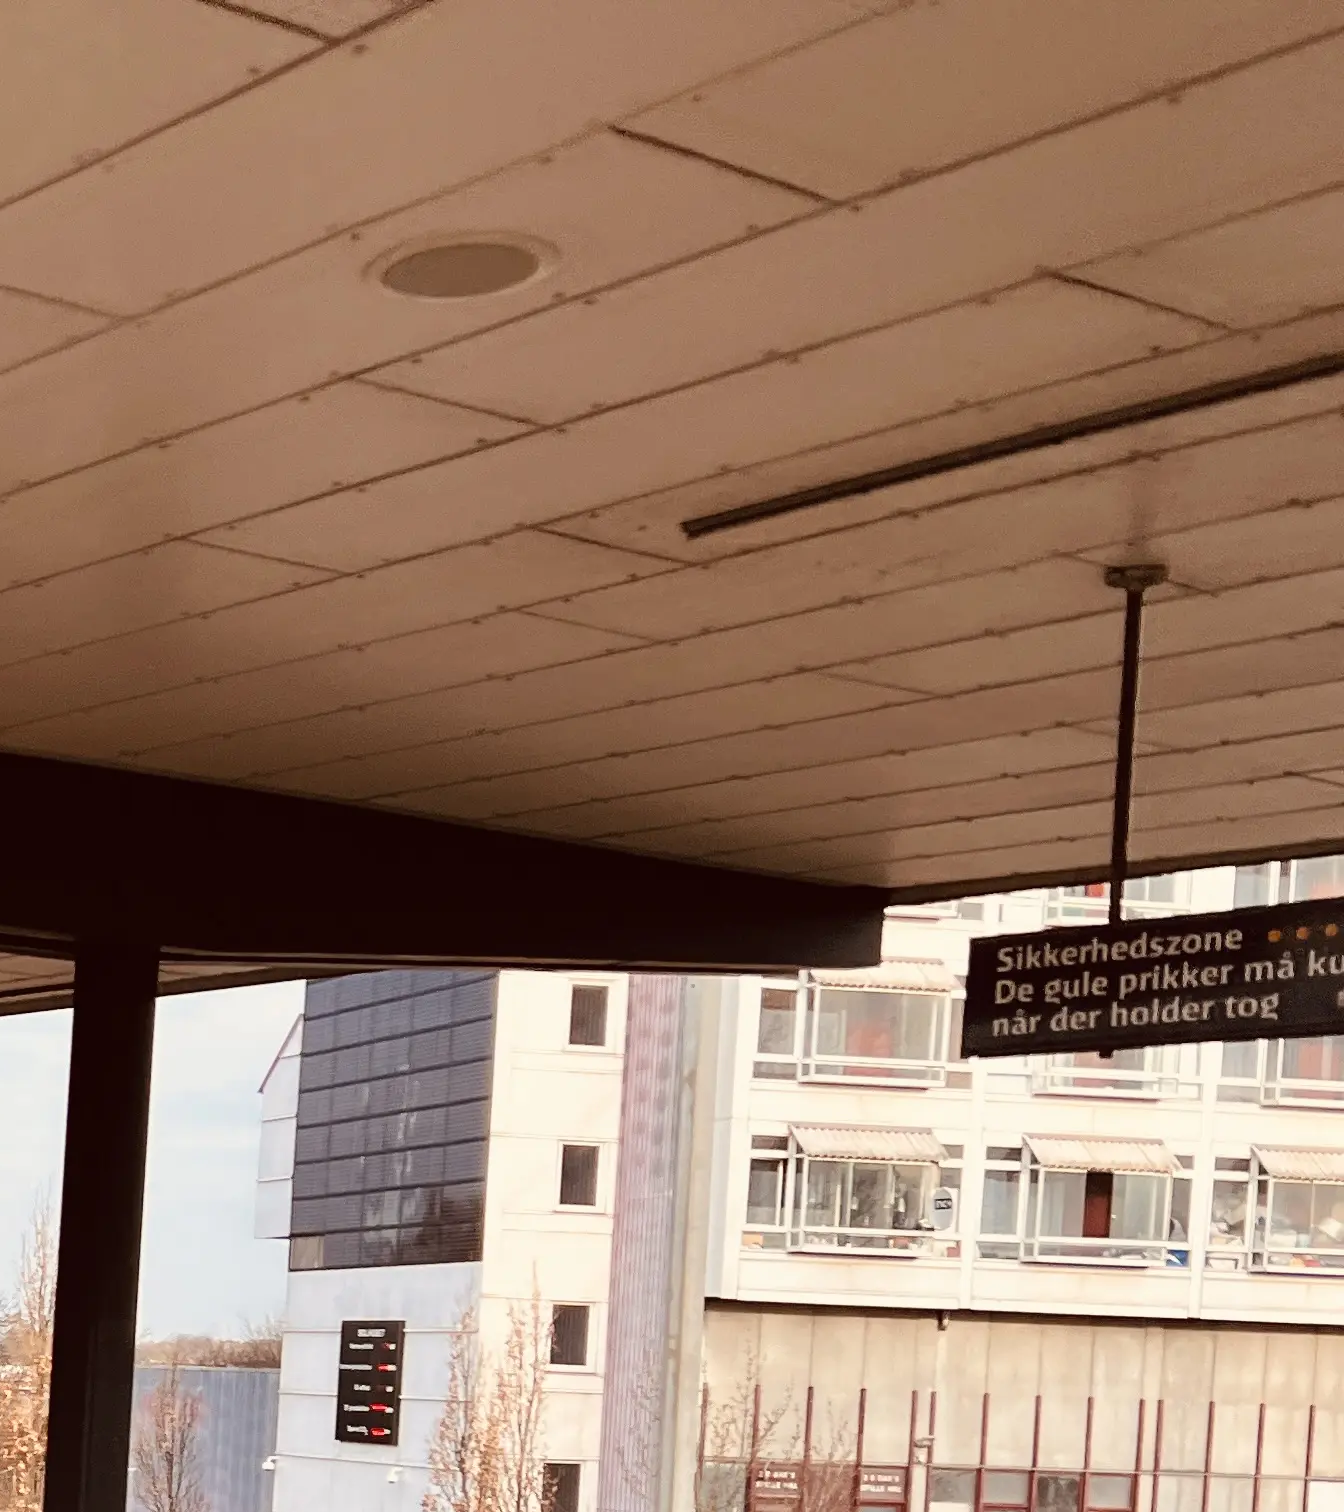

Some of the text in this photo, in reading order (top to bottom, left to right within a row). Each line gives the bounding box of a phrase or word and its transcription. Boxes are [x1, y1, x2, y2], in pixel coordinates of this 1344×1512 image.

[996, 929, 1242, 972] Sikkerhedszone
[995, 979, 1034, 1004] De
[1044, 971, 1108, 1004] gule
[1119, 961, 1234, 1000] prikker
[1244, 950, 1294, 982] må
[993, 992, 1279, 1037] når der holder tog
